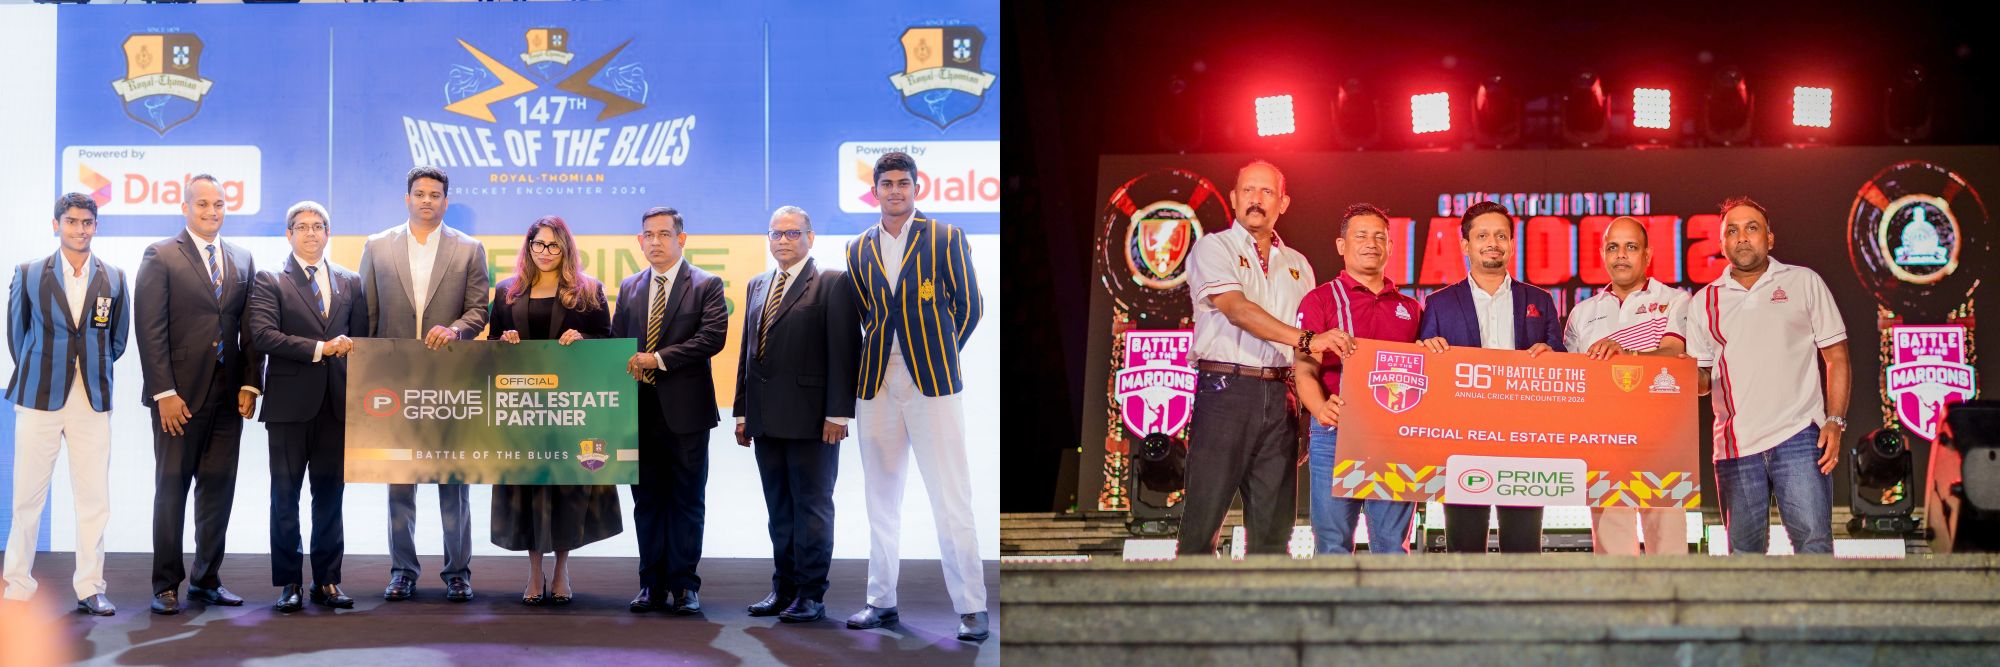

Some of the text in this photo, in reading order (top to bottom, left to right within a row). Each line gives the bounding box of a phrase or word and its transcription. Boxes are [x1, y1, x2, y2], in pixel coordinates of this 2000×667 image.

[403, 114, 696, 168] BATTLE OF THE BLUES
[78, 149, 145, 160] Powered by
[856, 145, 926, 156] Powered by
[489, 173, 605, 183] ROYAL-THOMIAN
[124, 173, 244, 212] Diag
[448, 186, 647, 195] CRICKET ENCOUNTER 2026
[1131, 337, 1188, 353] BATTLE
[1900, 333, 1958, 348] BATTLE
[1380, 354, 1420, 365] BATTLE
[1372, 373, 1425, 387] MAROONS
[1506, 365, 1545, 380] BATTLE
[1548, 367, 1563, 380] OF
[1565, 368, 1586, 381] THE
[1892, 366, 1969, 387] MAROONS
[500, 377, 554, 386] OFFICIAL
[1121, 370, 1195, 391] MAROONS
[1506, 379, 1586, 393] MAROONS
[404, 389, 482, 405] PRIME
[496, 391, 620, 408] REAL ESTATE
[1455, 391, 1486, 399] ANNUAL
[1487, 392, 1519, 401] CRICKET
[1520, 394, 1567, 402] ENCOUNTER
[403, 406, 483, 420] GROUP
[496, 410, 586, 426] PARTNER
[1398, 425, 1638, 445] OFFICIAL REAL ESTATE PARTNER
[416, 451, 569, 460] BATTLE OF THE BLUES
[1497, 470, 1574, 484] PRIME
[1496, 484, 1575, 498] GROUP
